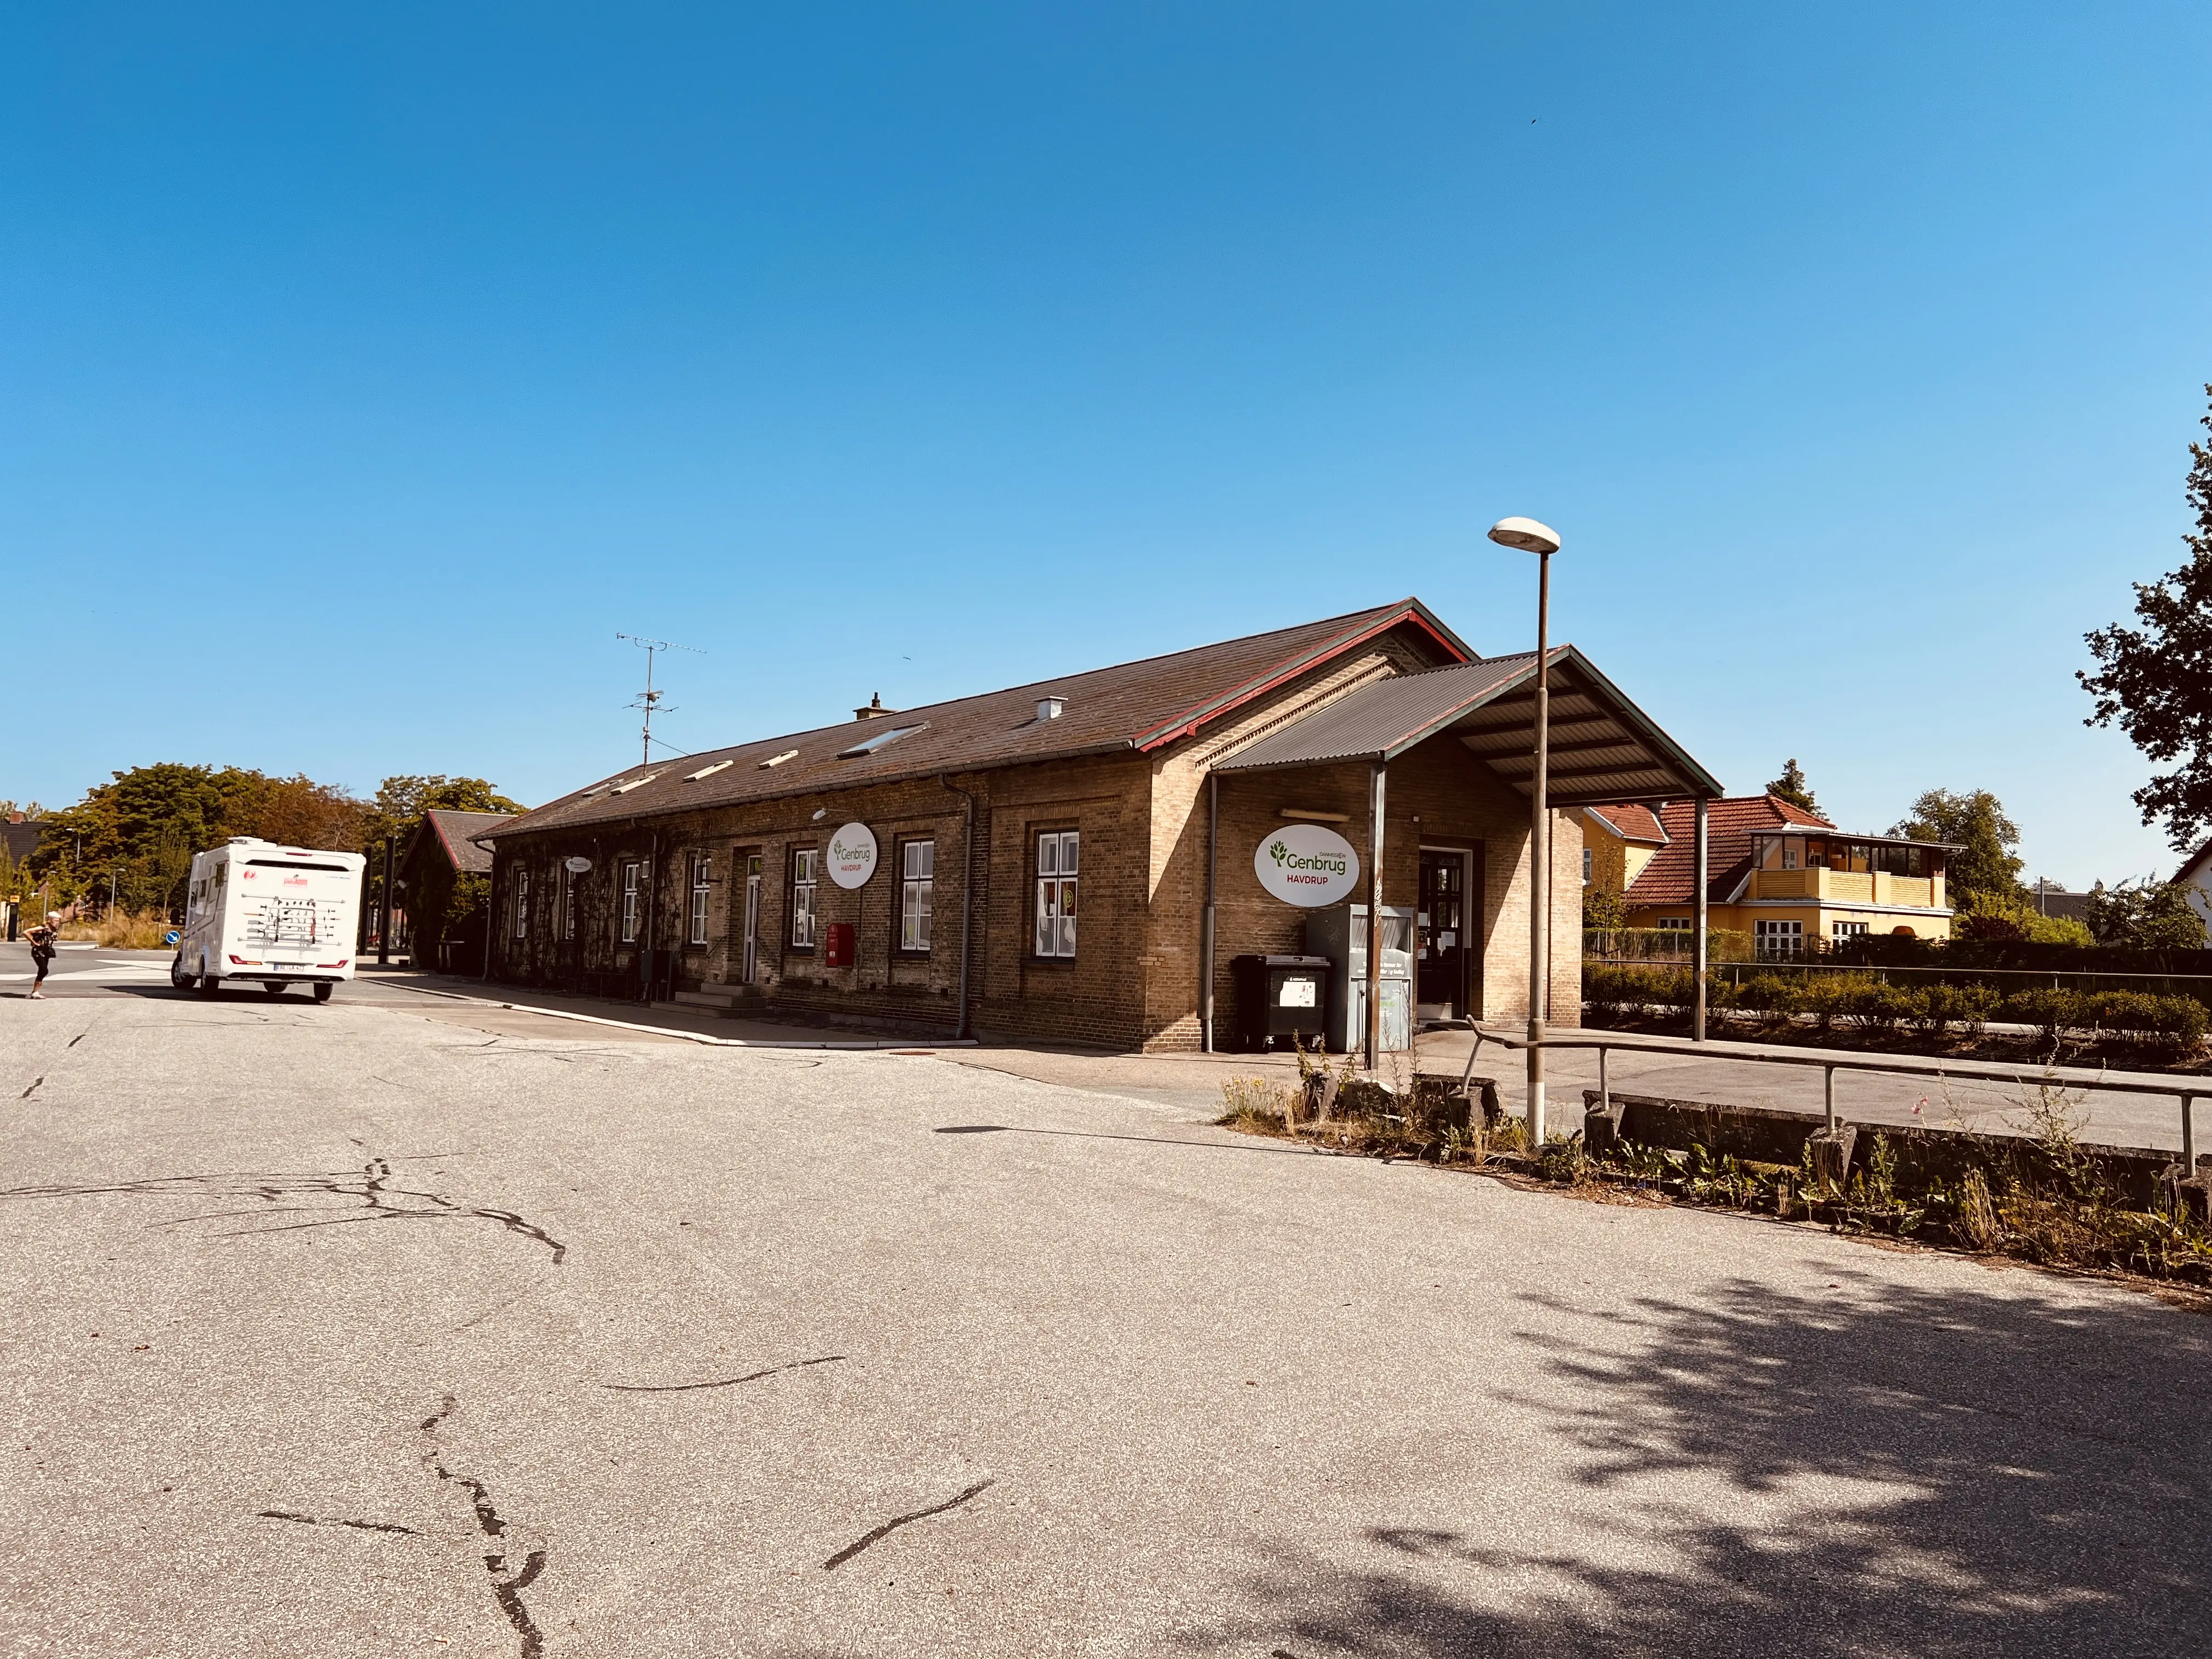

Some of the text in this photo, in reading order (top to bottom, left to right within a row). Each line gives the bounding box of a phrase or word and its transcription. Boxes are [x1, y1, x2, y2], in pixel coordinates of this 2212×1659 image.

[842, 847, 870, 862] Genbrug
[1286, 854, 1346, 876] Genbrug
[1286, 874, 1328, 885] HAVDRUP
